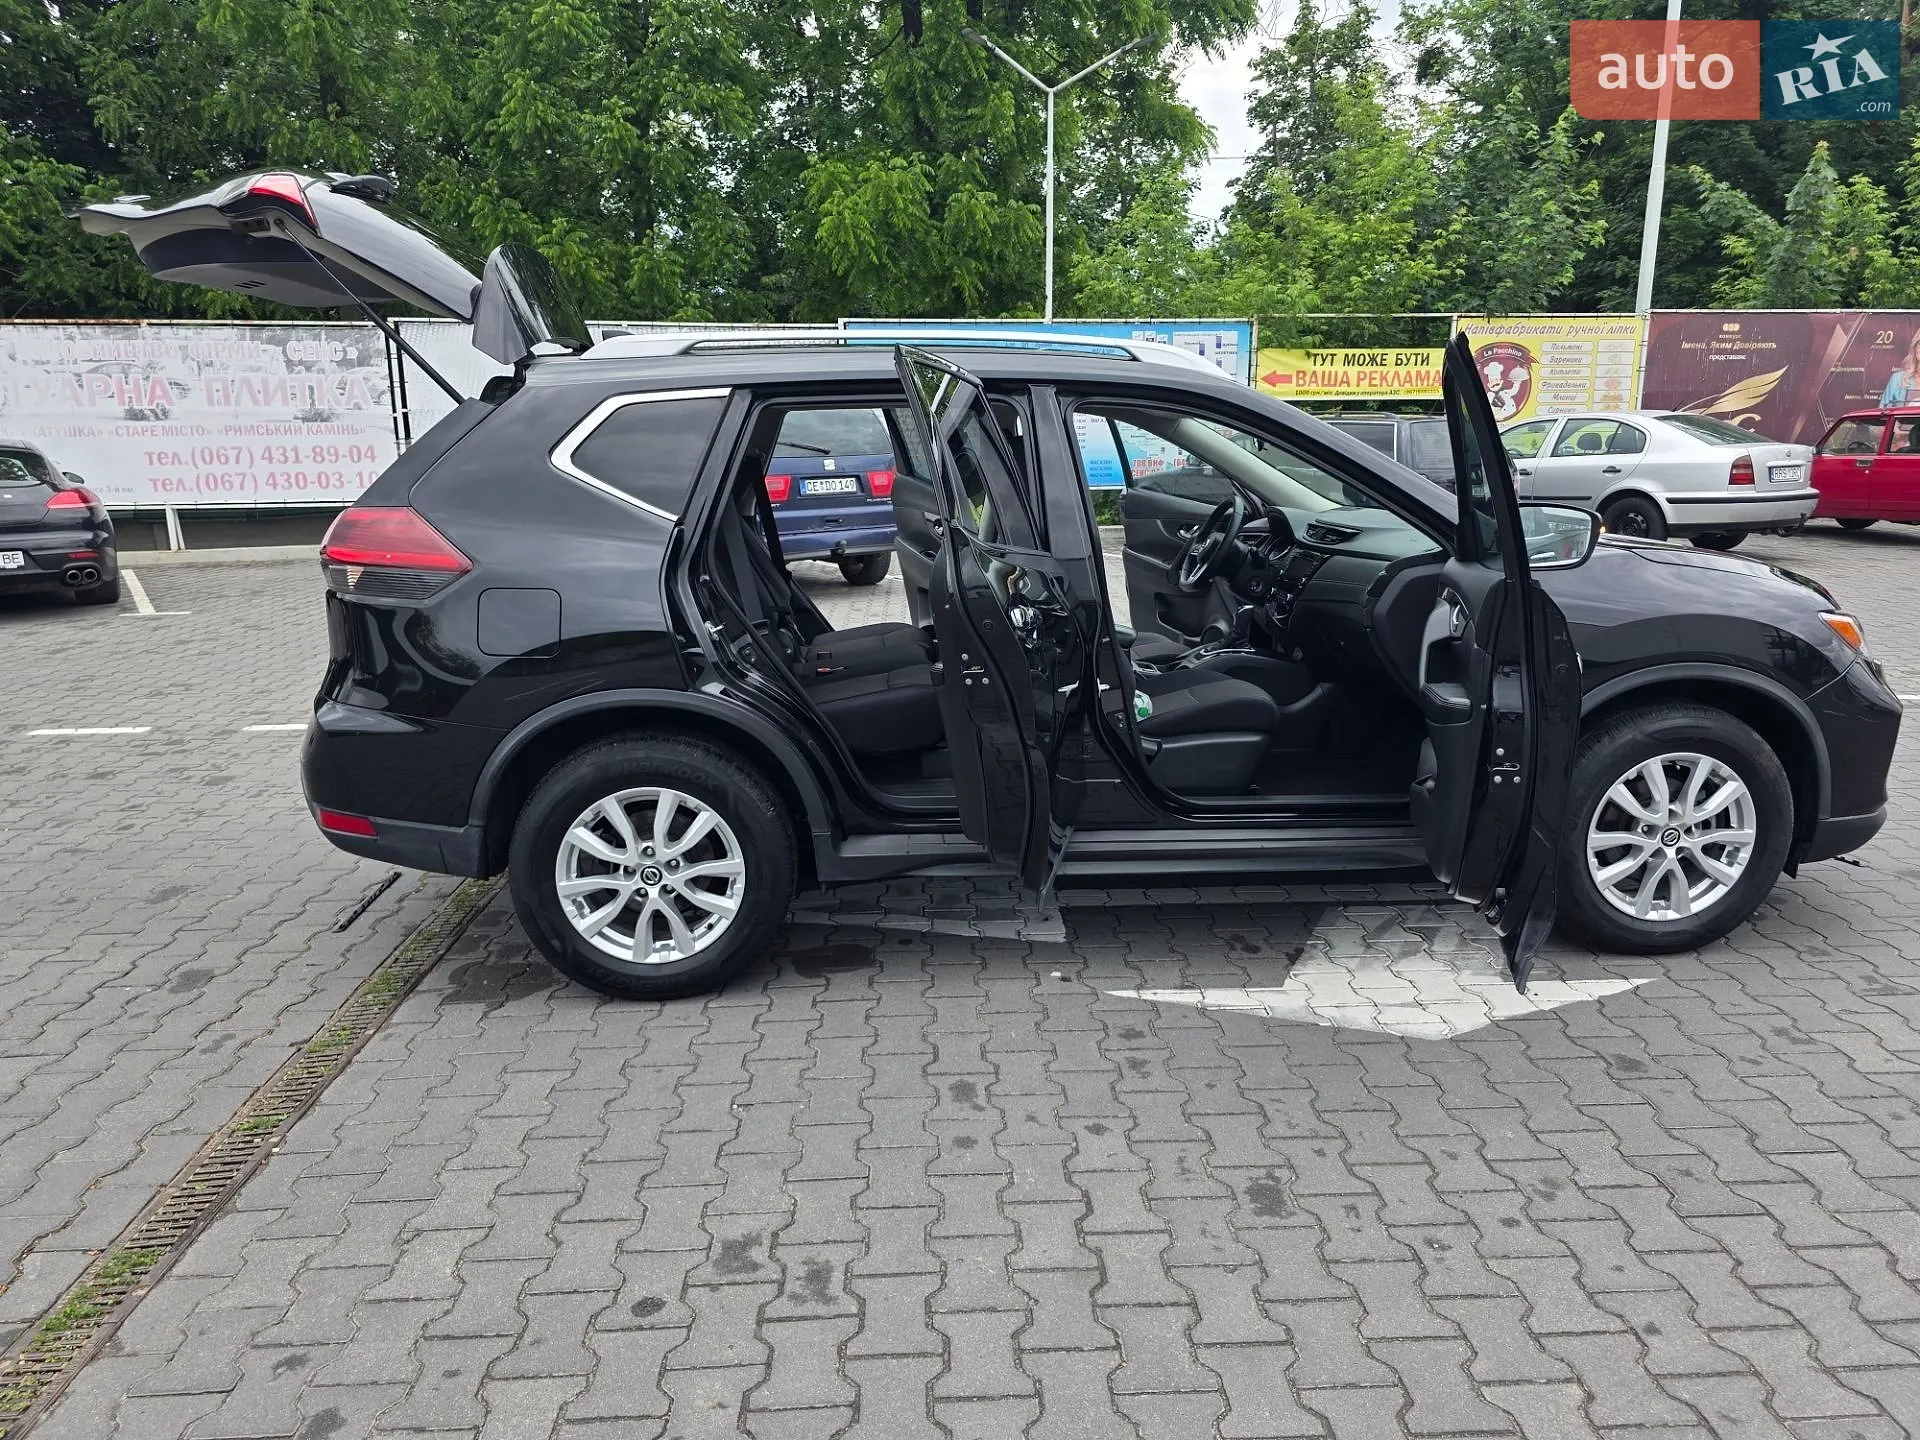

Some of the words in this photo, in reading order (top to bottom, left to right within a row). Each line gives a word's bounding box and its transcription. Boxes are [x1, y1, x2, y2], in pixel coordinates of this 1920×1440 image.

[1465, 322, 1563, 337] Напівфабрикати
[1566, 321, 1608, 338] ручної
[1607, 322, 1638, 336] ліпки
[1875, 330, 1894, 344] 20
[1710, 341, 1732, 349] Яким
[1733, 341, 1777, 351] Довіряють
[1312, 353, 1337, 367] ТУТ
[1343, 353, 1388, 367] МОЖЕ
[1395, 352, 1430, 366] БУТИ
[1295, 370, 1351, 388] ВАША
[1356, 370, 1442, 388] РЕКЛАМА
[203, 374, 373, 408] ПЛИТКА
[260, 444, 377, 465] 431-89-04
[807, 481, 819, 492] CE
[839, 479, 855, 490] 149
[2, 553, 21, 565] BE
